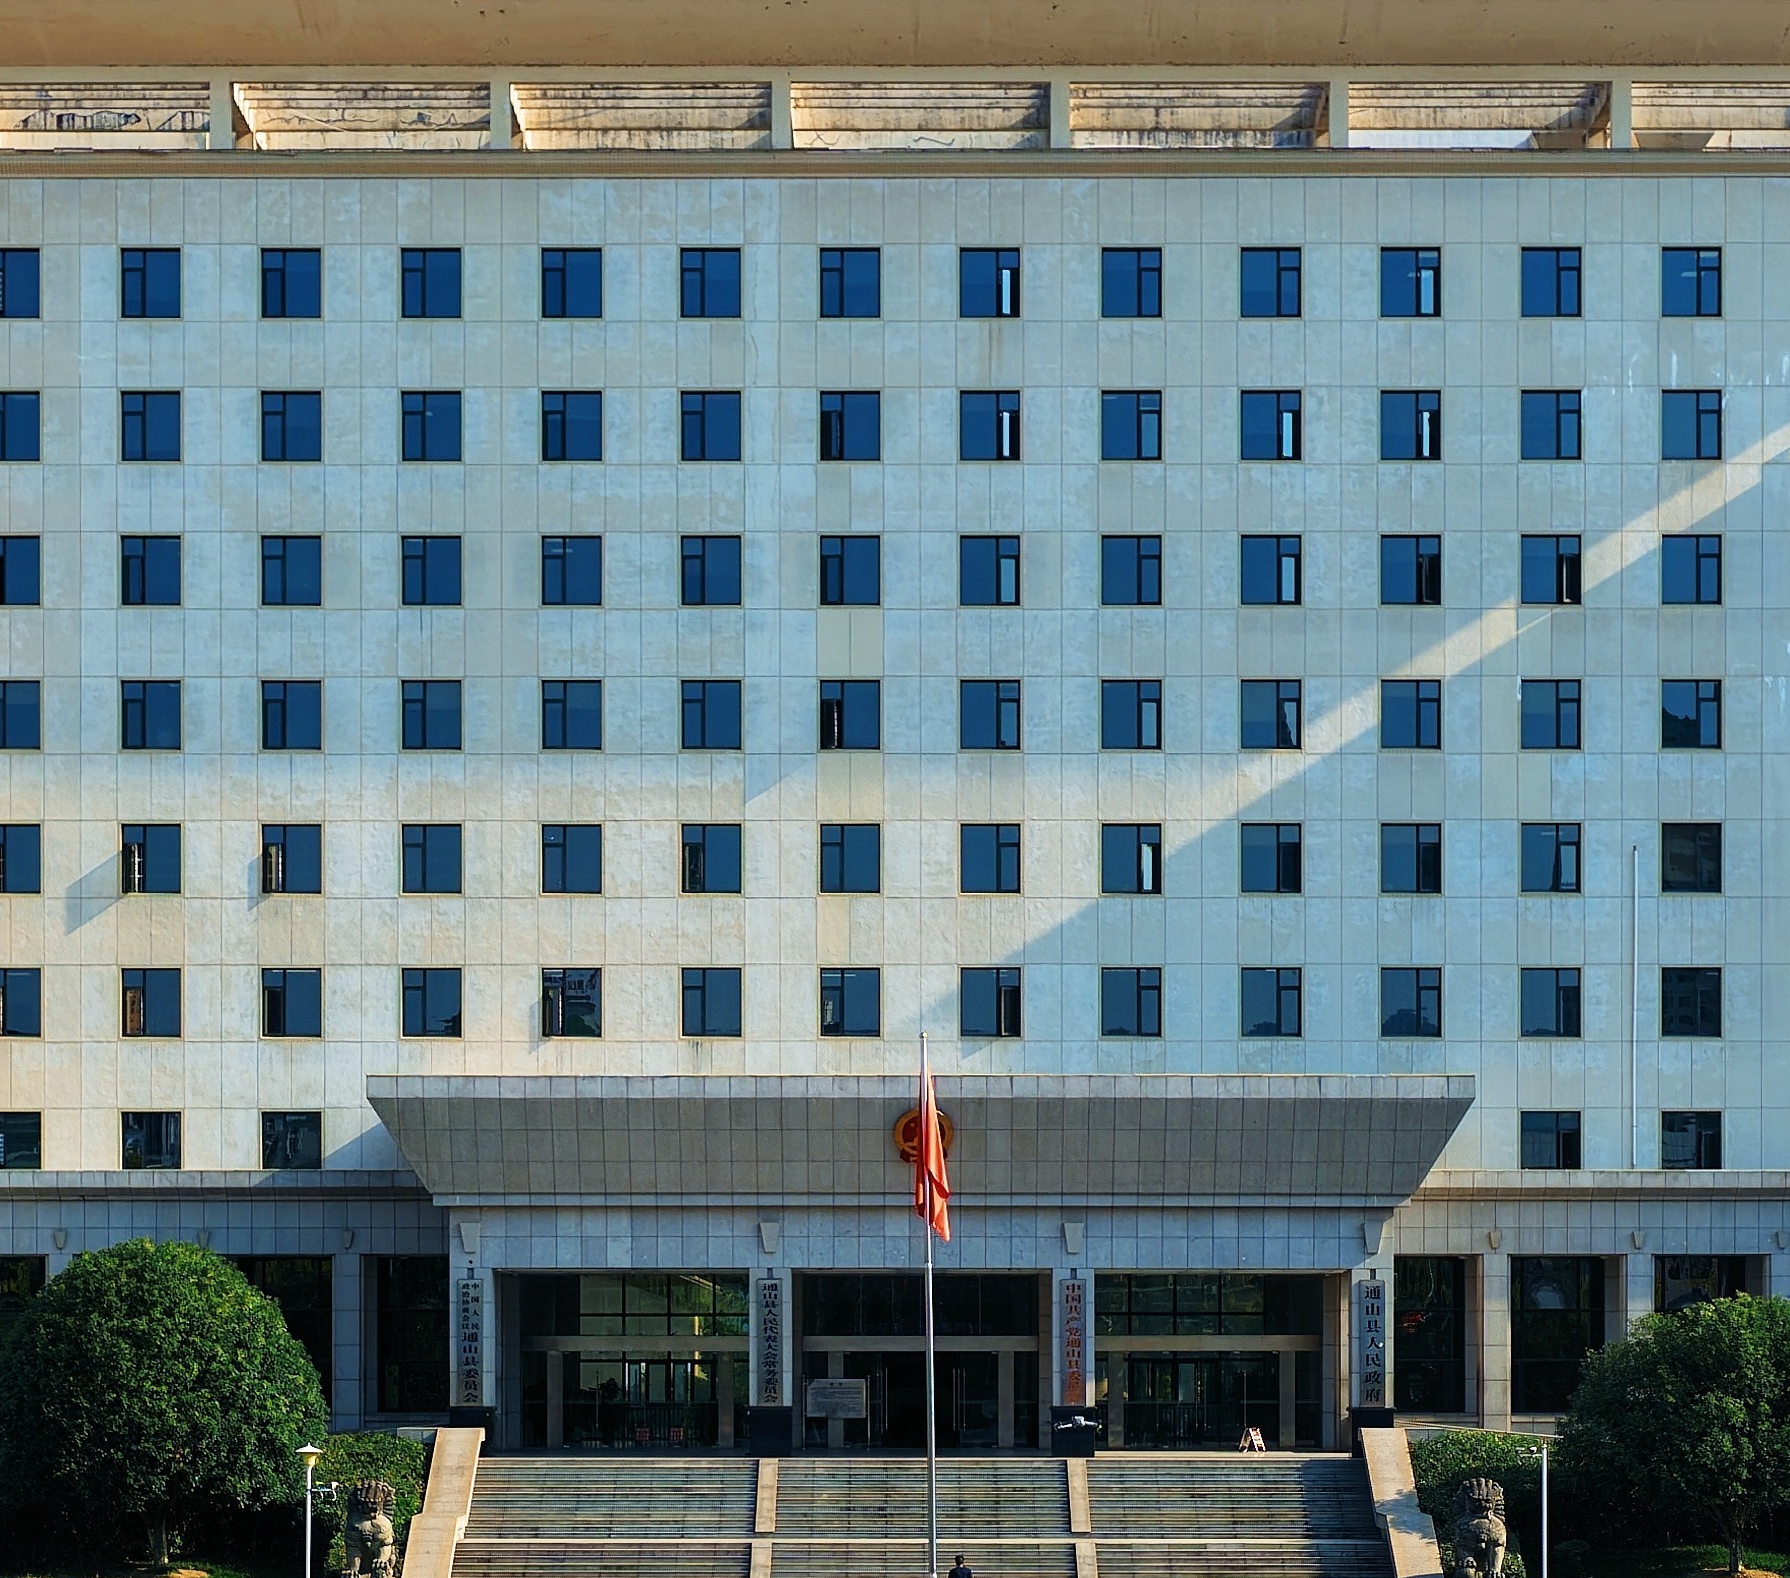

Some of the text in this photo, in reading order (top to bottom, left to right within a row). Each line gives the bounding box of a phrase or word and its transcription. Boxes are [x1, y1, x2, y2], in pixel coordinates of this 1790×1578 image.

[1364, 1284, 1382, 1402] 通山县人民政府
